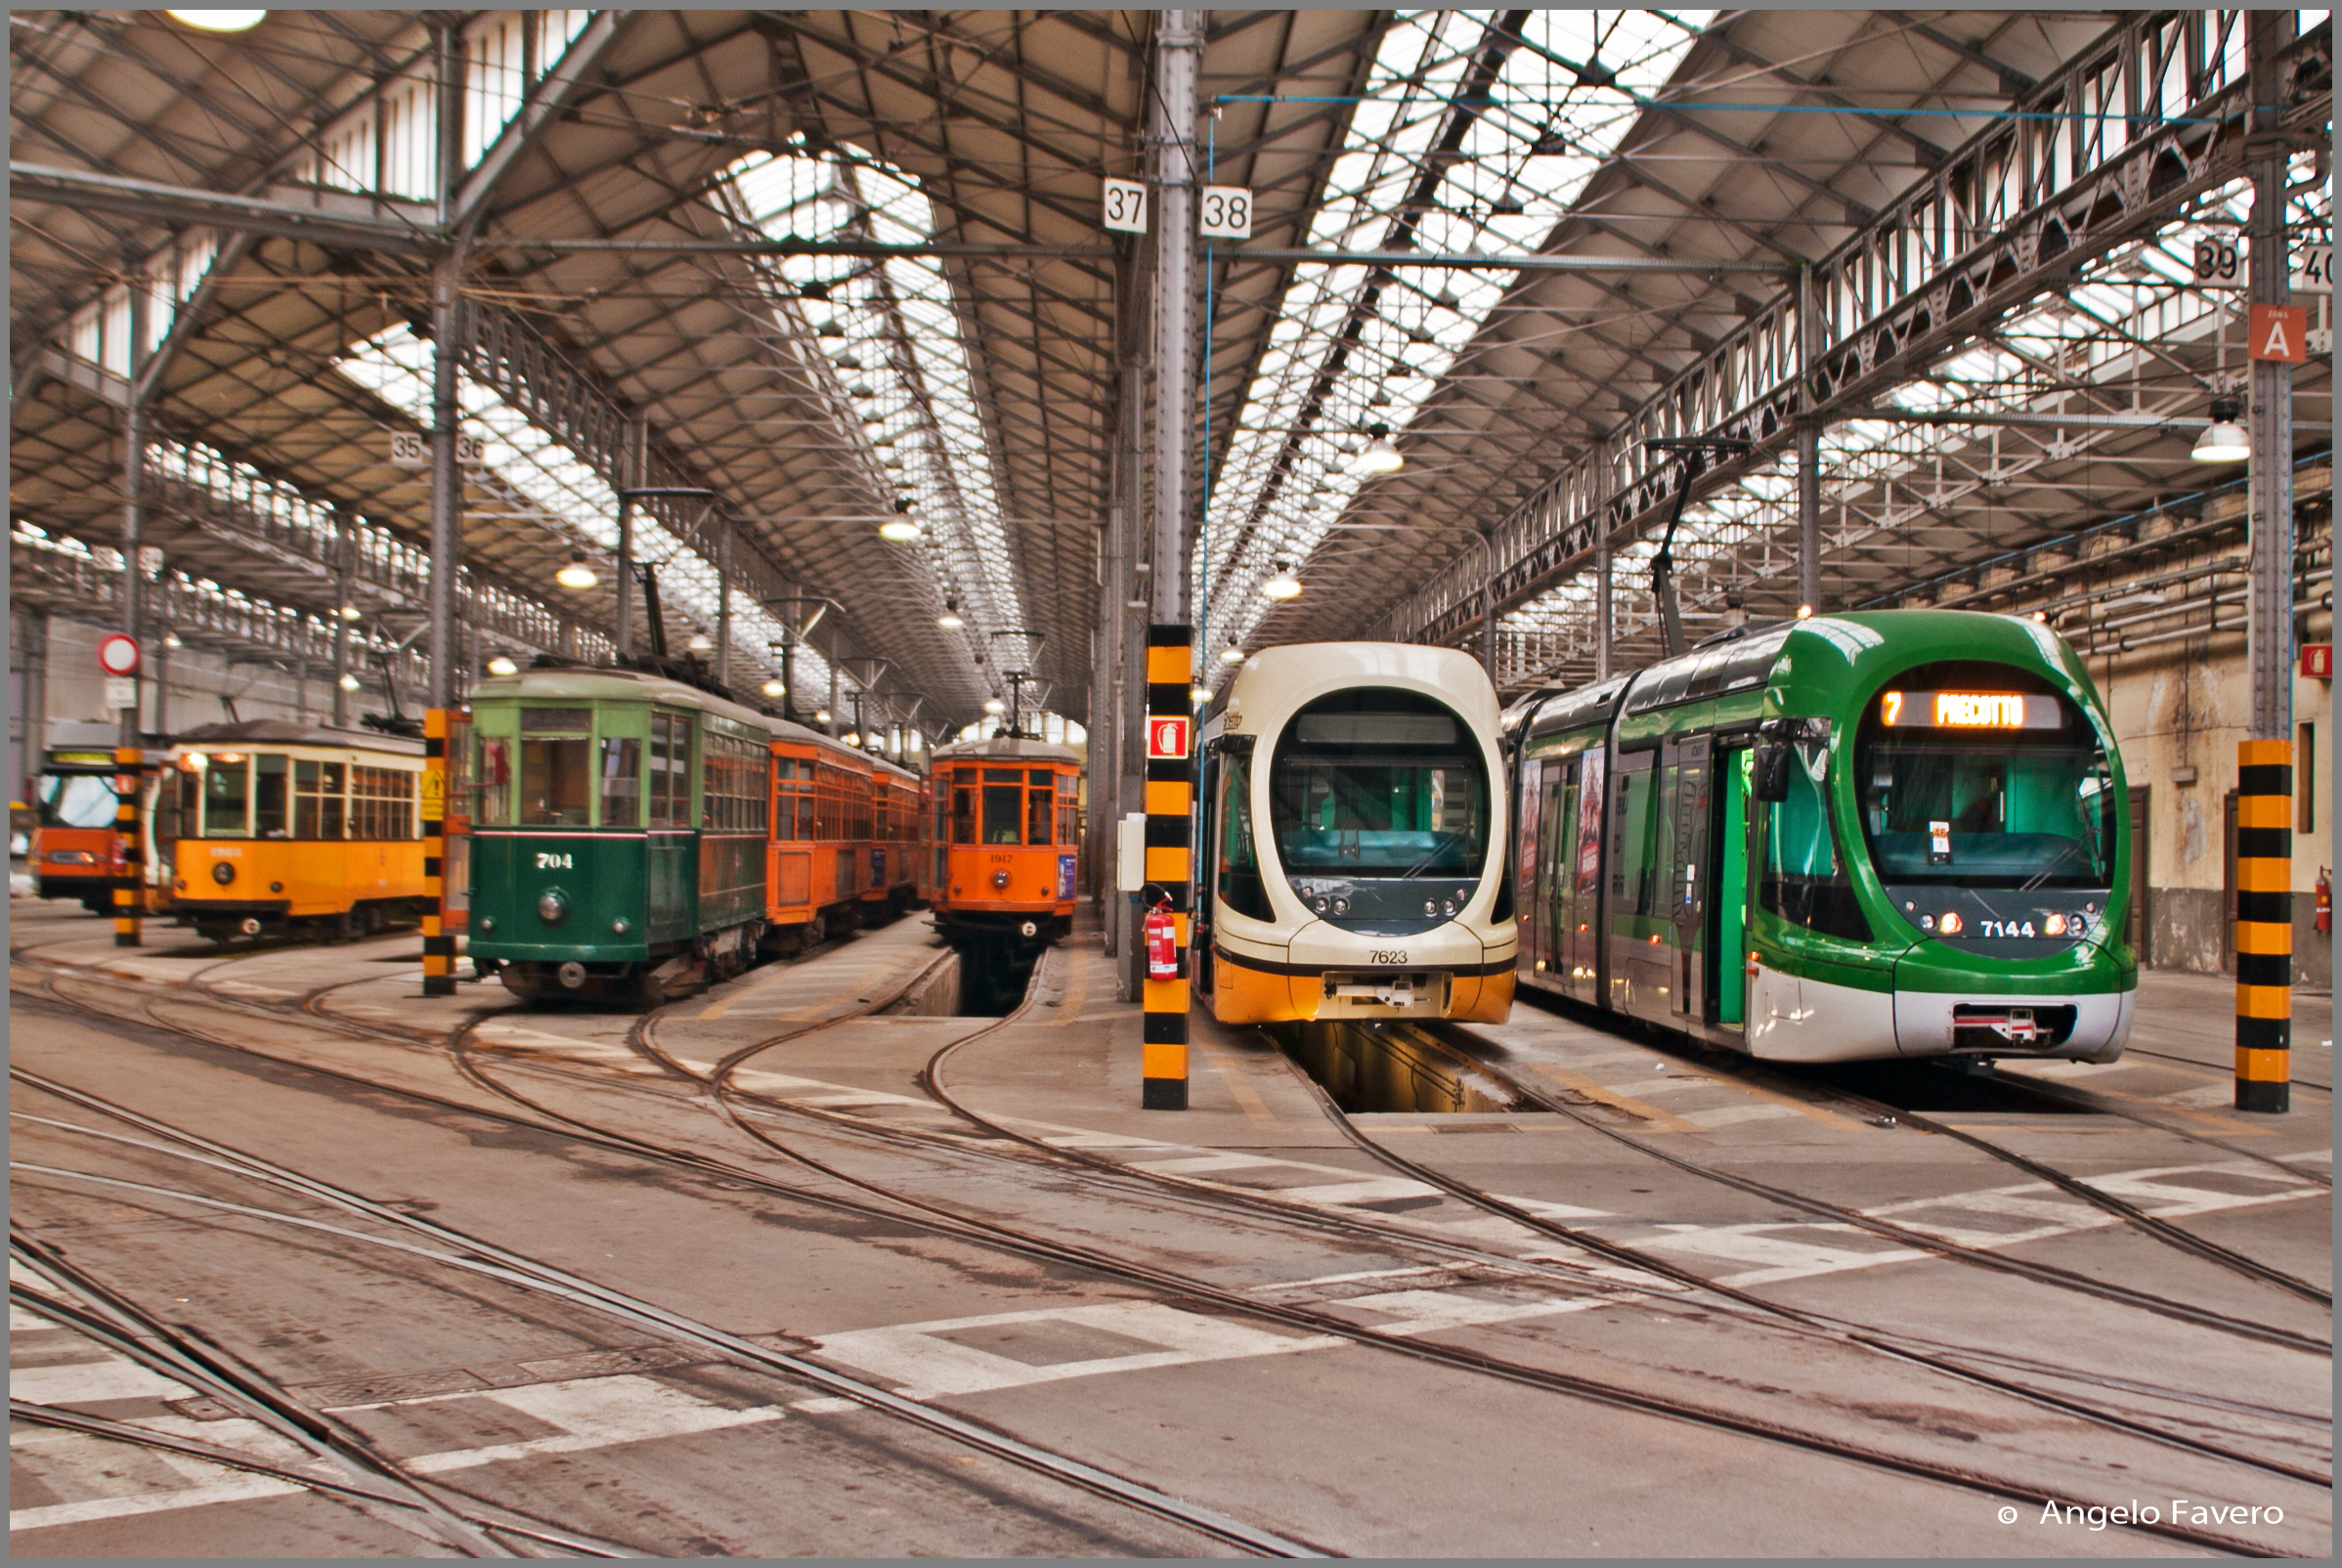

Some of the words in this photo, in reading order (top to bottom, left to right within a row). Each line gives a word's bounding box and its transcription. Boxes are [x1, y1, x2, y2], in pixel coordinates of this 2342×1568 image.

[1107, 187, 1143, 225] 37
[1204, 194, 1247, 230] 38
[2199, 245, 2237, 280] 39
[2263, 321, 2290, 358] A
[394, 436, 420, 458] 35
[457, 436, 485, 458] 36
[1883, 691, 1902, 724] 7
[1936, 693, 2024, 725] PRECOTTO
[536, 852, 574, 869] 704
[990, 853, 1014, 864] 1917
[1979, 920, 2036, 938] 7144
[1368, 949, 1409, 965] 7623
